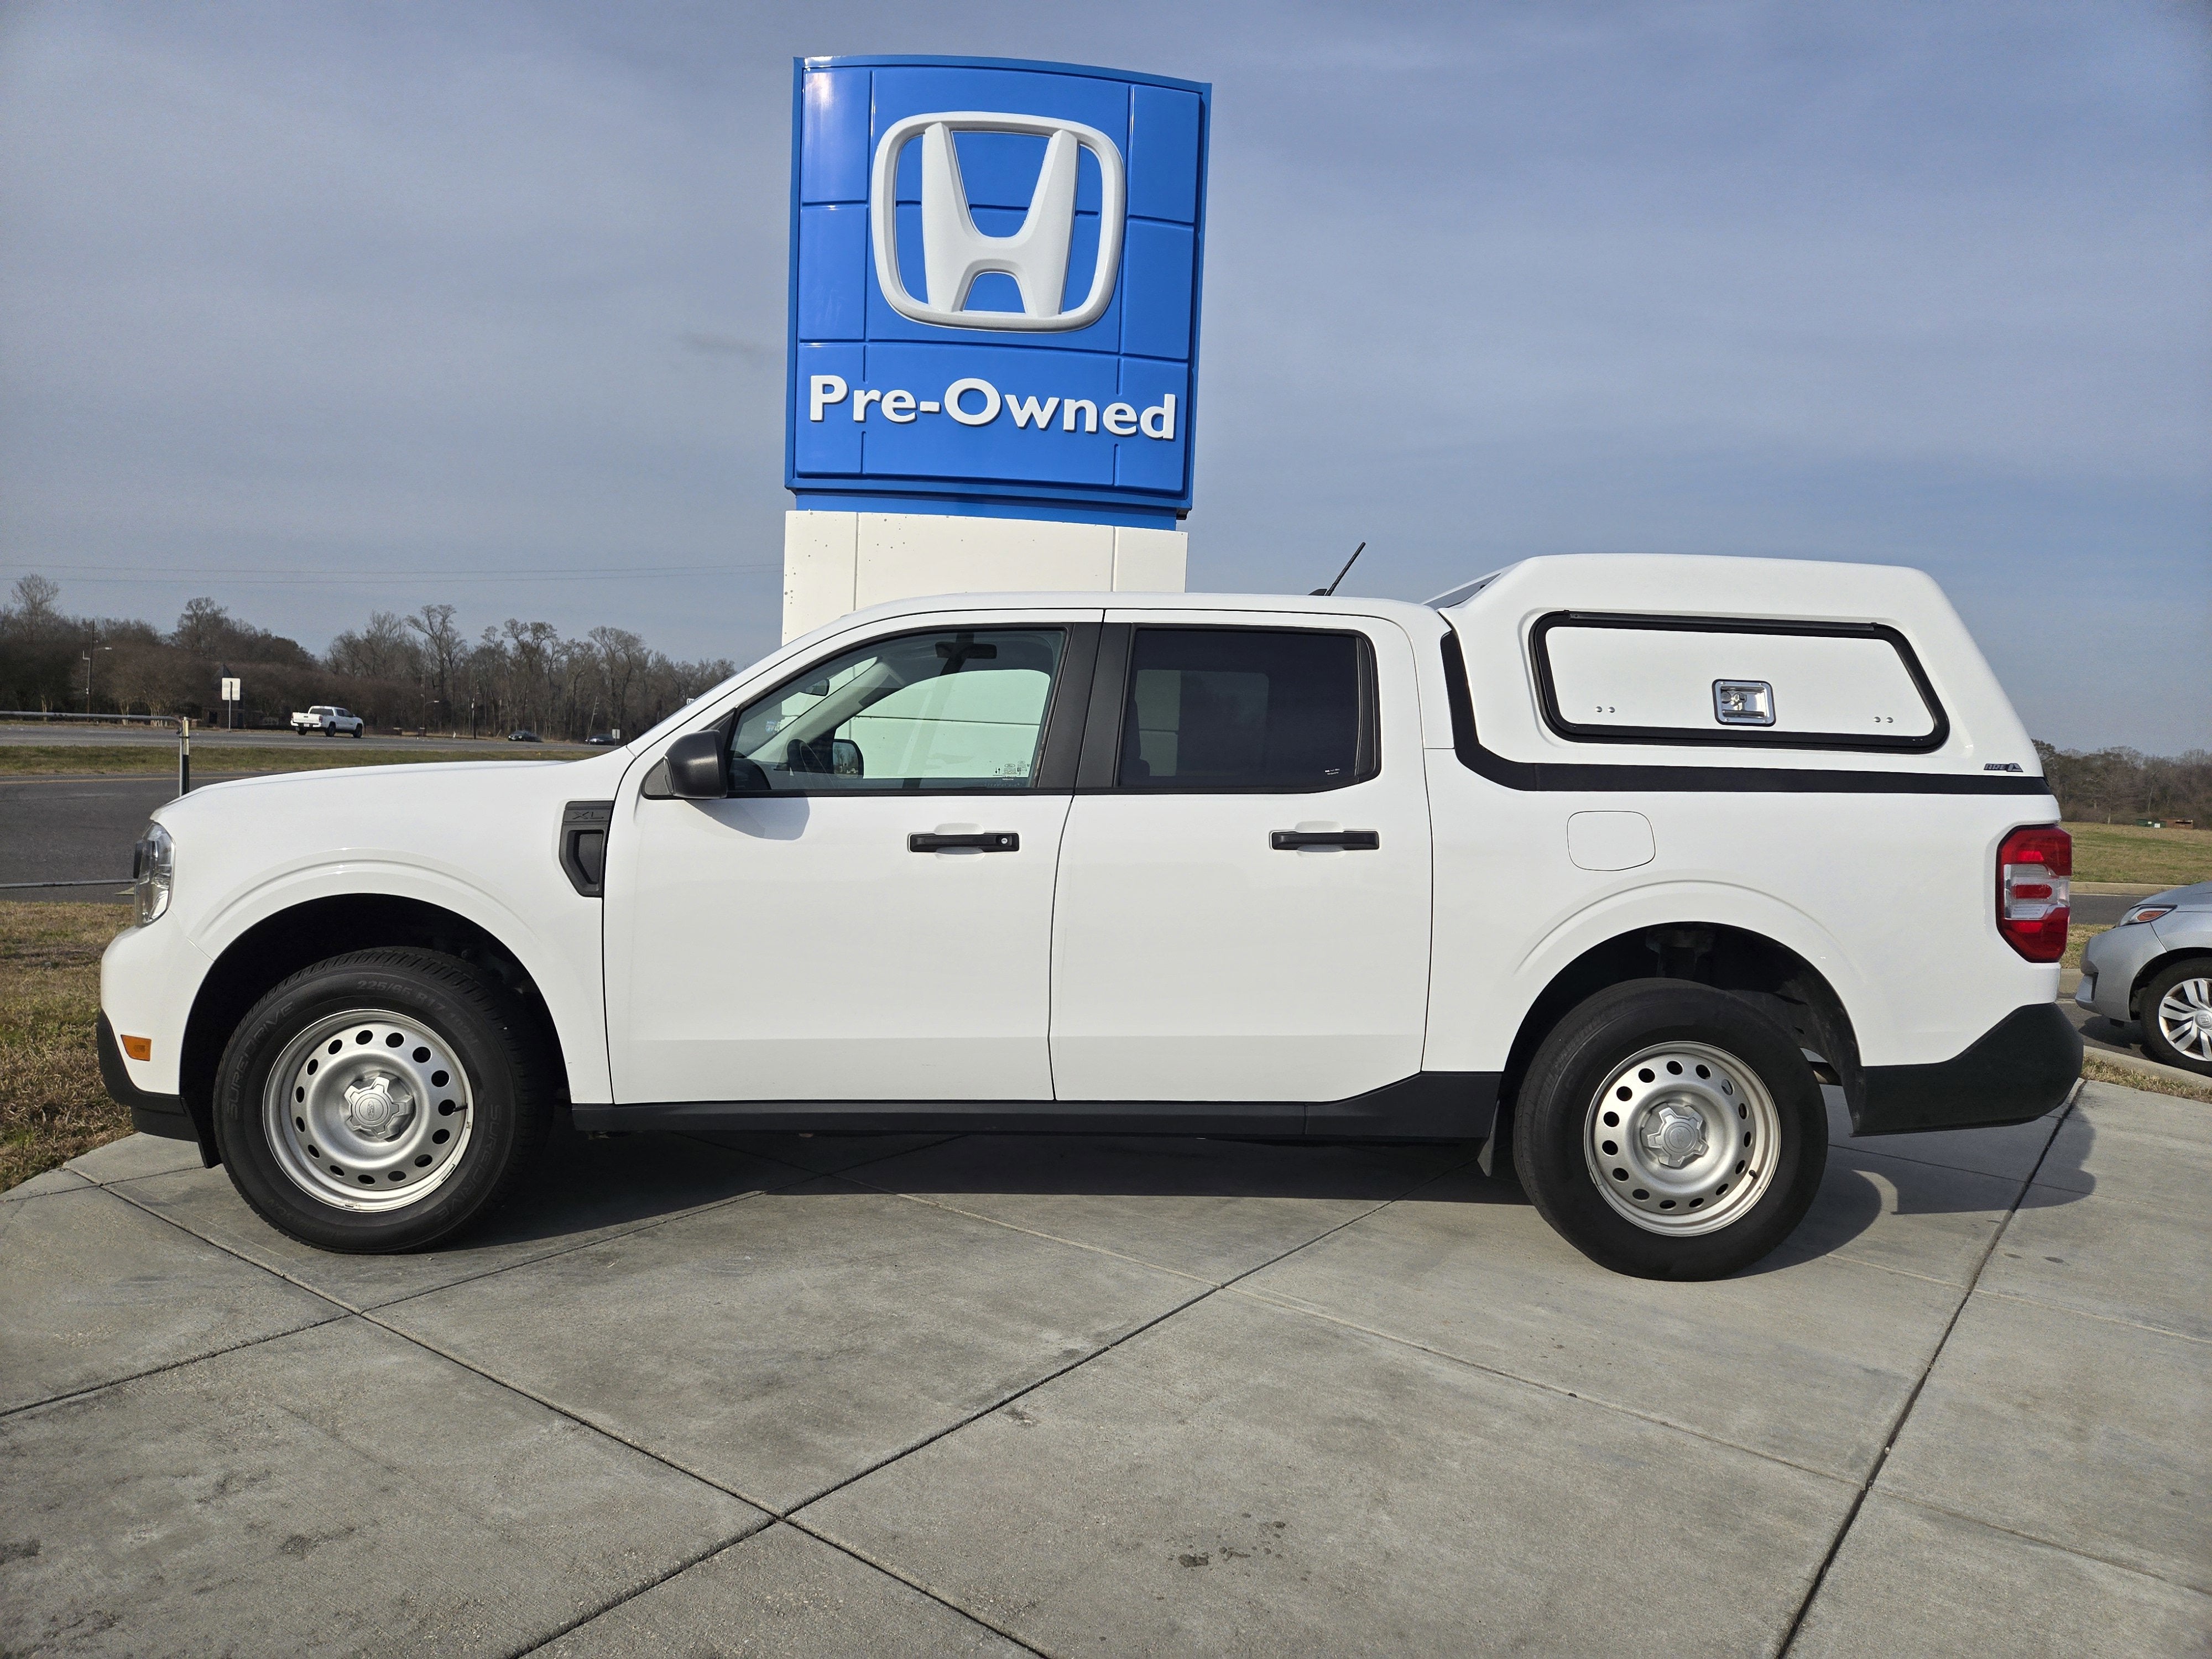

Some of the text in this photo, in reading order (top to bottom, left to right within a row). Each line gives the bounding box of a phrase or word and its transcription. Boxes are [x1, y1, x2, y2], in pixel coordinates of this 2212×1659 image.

[810, 374, 1176, 441] Pre-Owned
[572, 811, 604, 820] XL
[357, 980, 413, 995] 225/65
